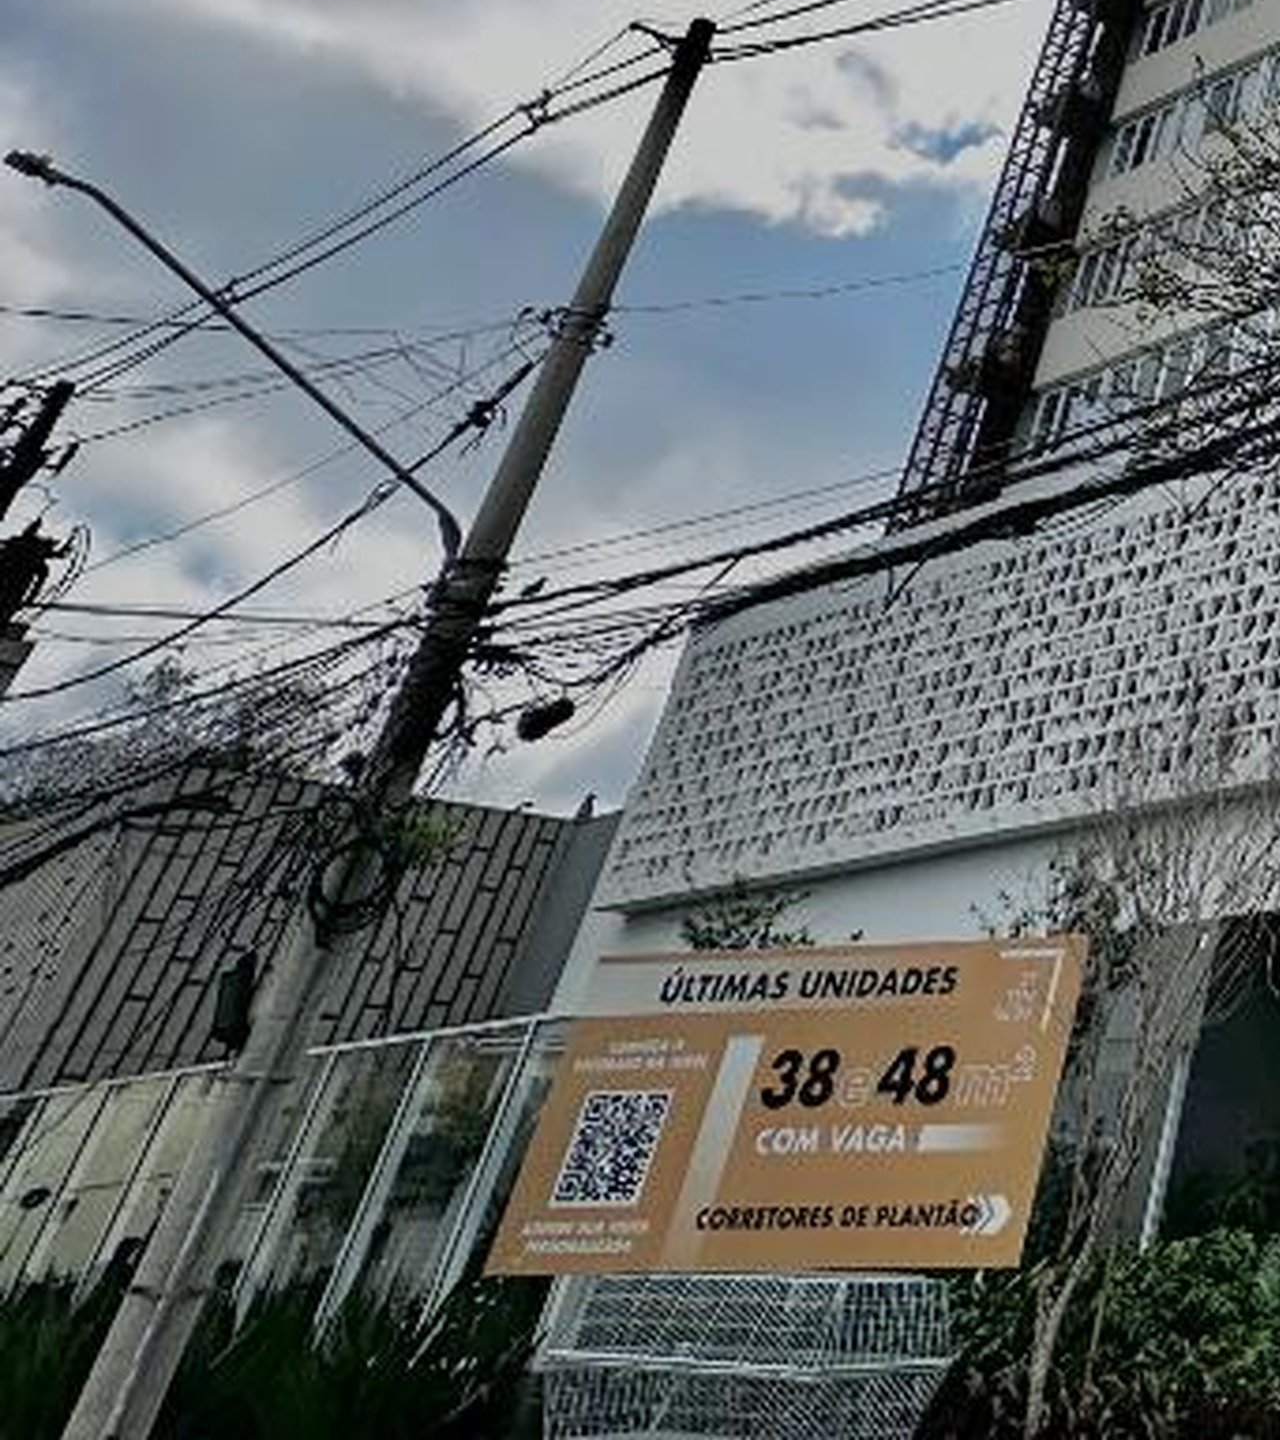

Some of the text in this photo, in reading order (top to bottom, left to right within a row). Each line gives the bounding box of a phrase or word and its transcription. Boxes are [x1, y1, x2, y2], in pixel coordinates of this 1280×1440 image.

[660, 967, 789, 1002] ÚLTIMAS
[799, 966, 958, 999] UNIDADES
[761, 1048, 840, 1110] 38
[877, 1045, 956, 1107] 48
[755, 1124, 906, 1155] COM VAGA
[696, 1199, 982, 1231] CORRETORES DE PLANTÃO
